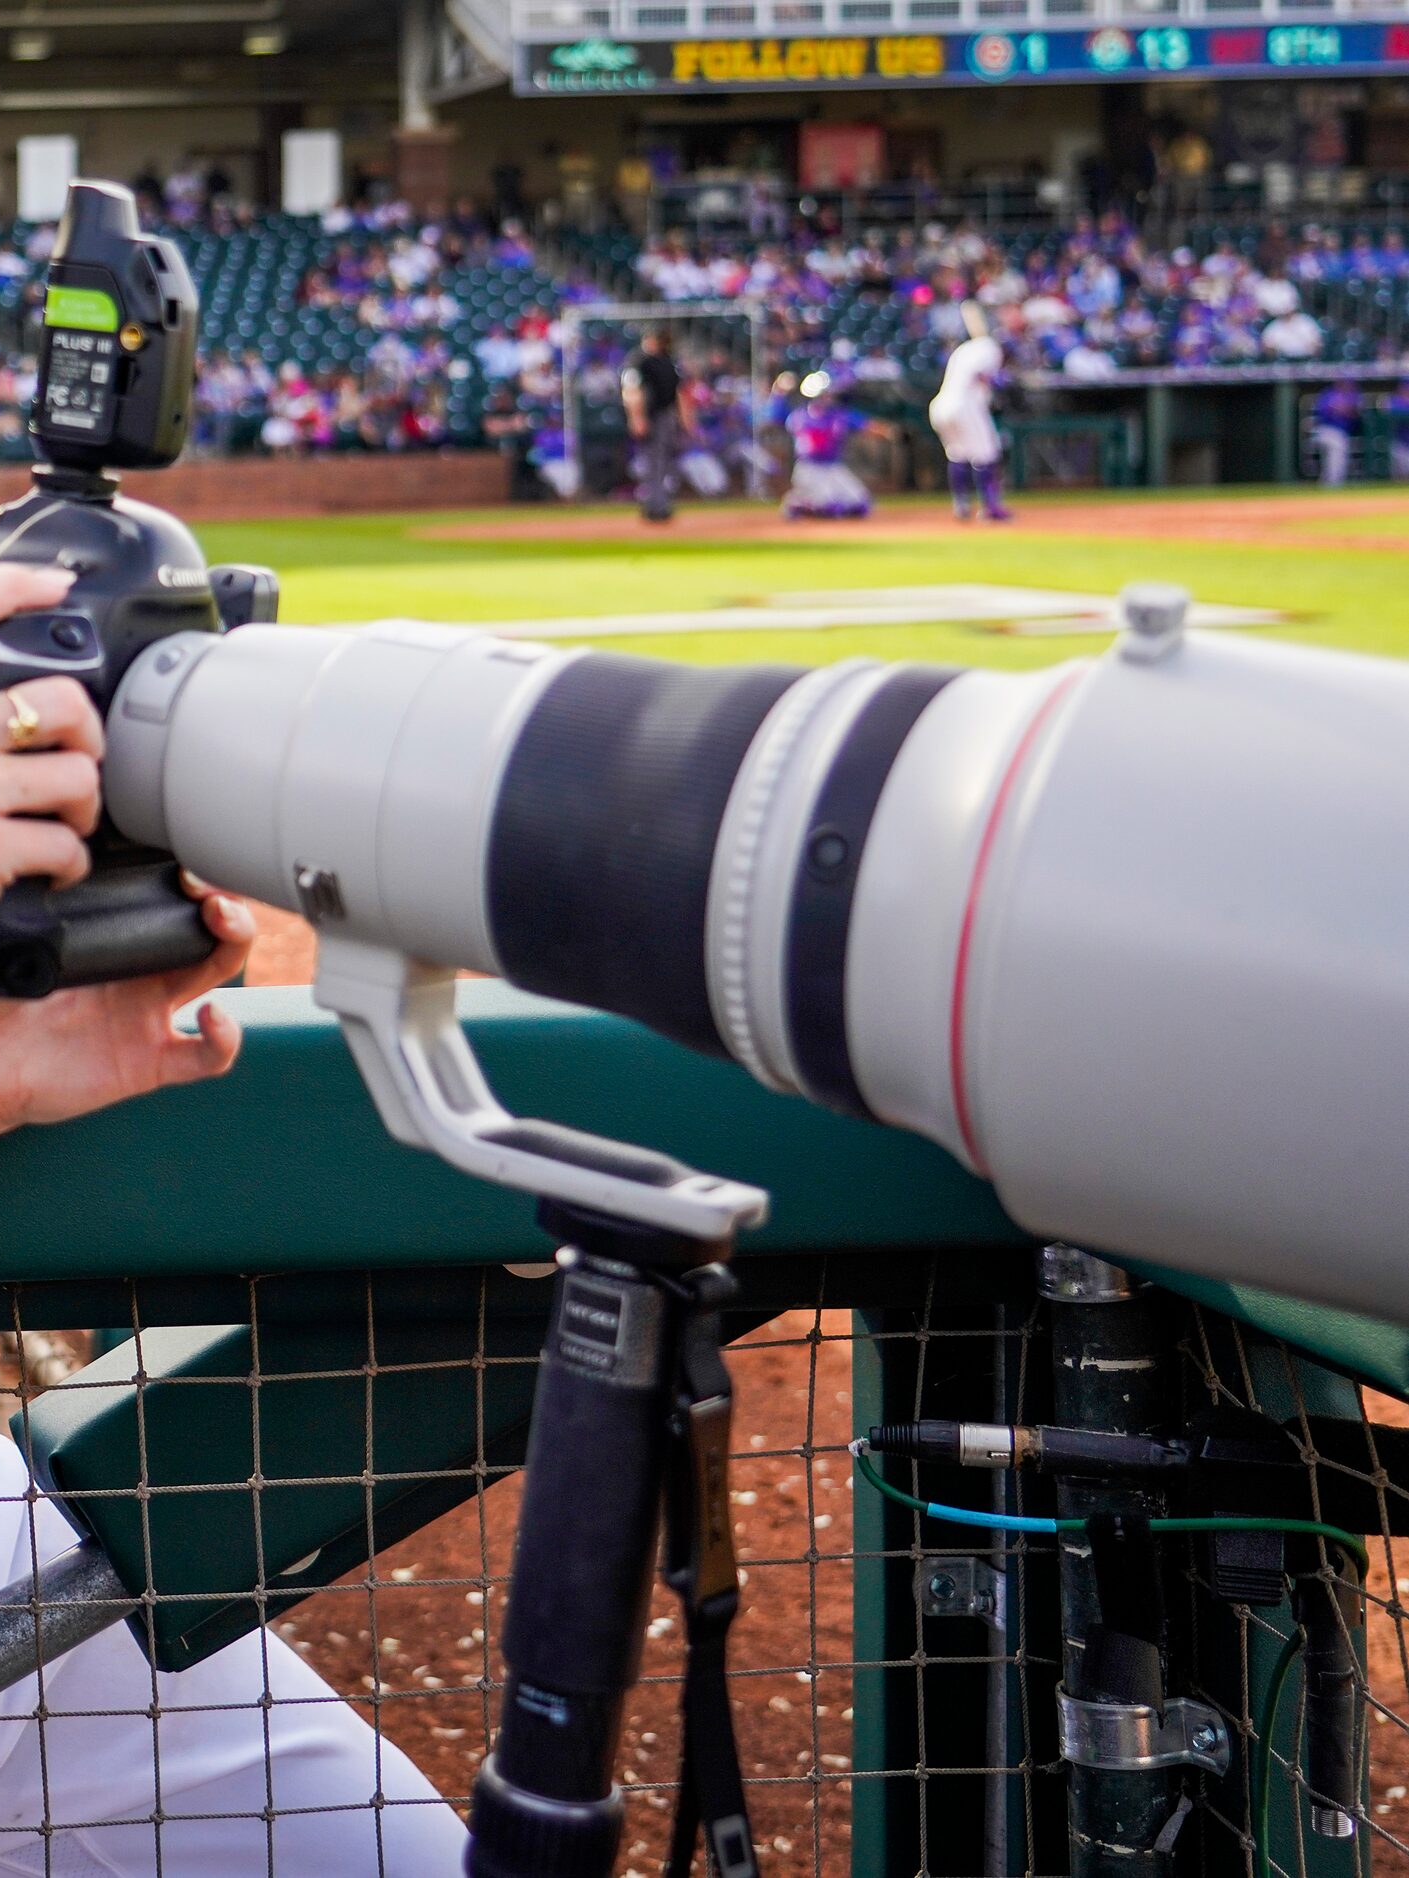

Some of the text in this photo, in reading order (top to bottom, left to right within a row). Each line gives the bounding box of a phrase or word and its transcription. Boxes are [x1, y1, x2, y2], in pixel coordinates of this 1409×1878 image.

[670, 35, 868, 83] FOLLOW
[876, 34, 945, 79] US
[1021, 30, 1049, 75] 1
[1137, 25, 1190, 71] 13
[52, 332, 94, 352] PLUS
